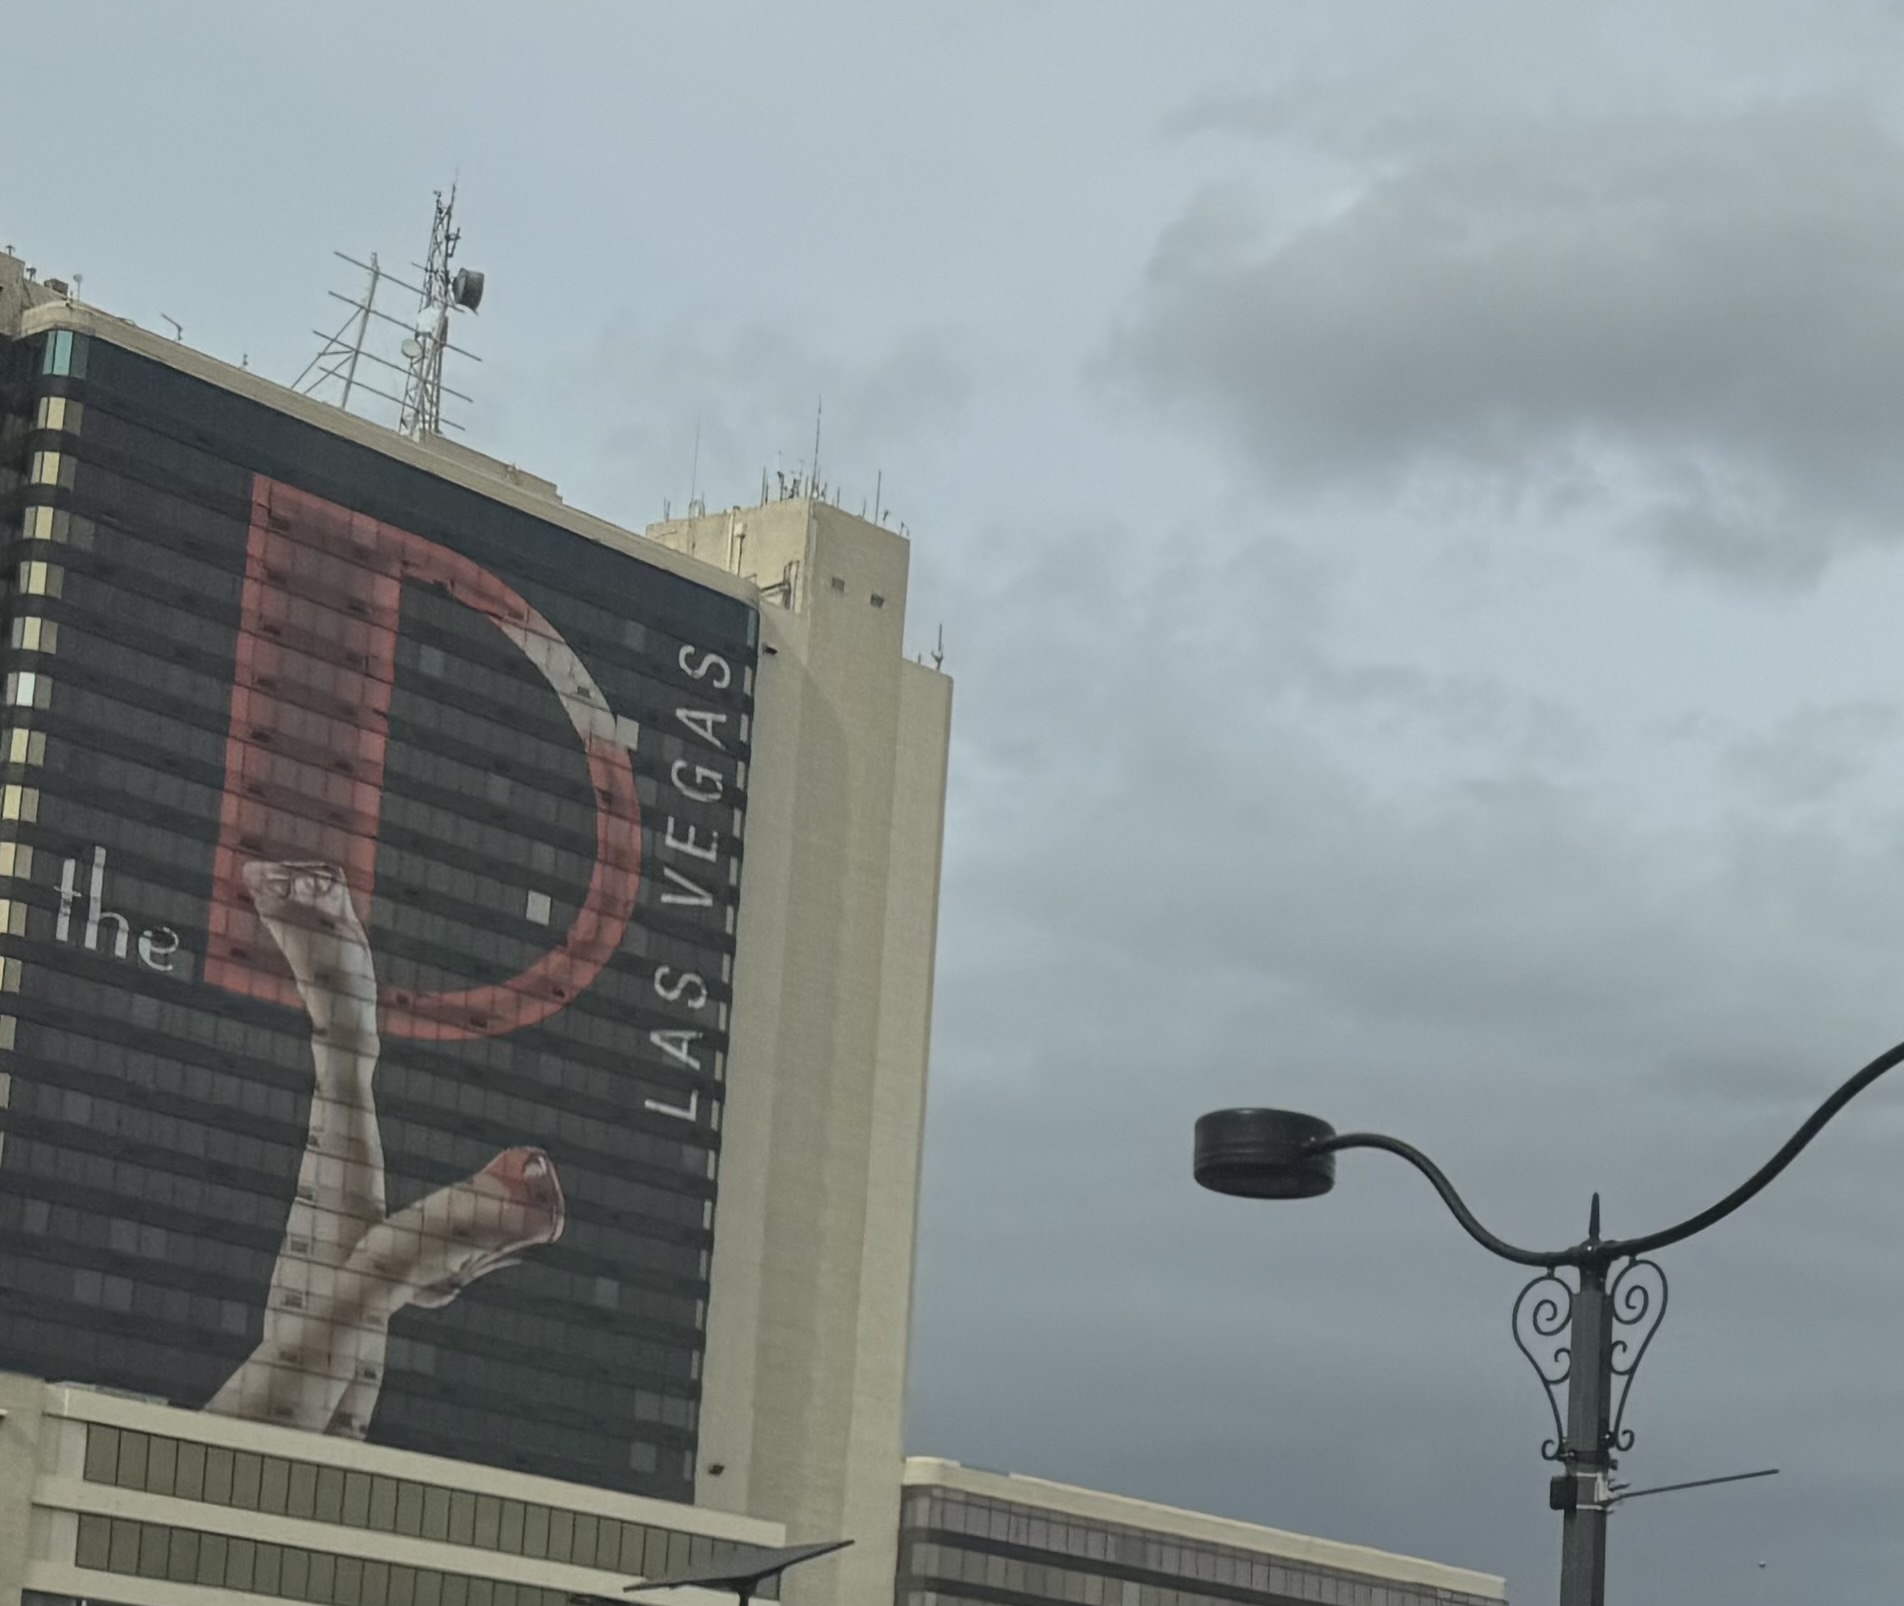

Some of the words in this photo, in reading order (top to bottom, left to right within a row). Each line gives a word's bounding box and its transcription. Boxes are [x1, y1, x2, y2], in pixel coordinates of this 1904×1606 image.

[53, 845, 179, 971] the
[206, 473, 640, 1039] D
[660, 644, 731, 907] VEGAS
[644, 965, 707, 1121] LAS
